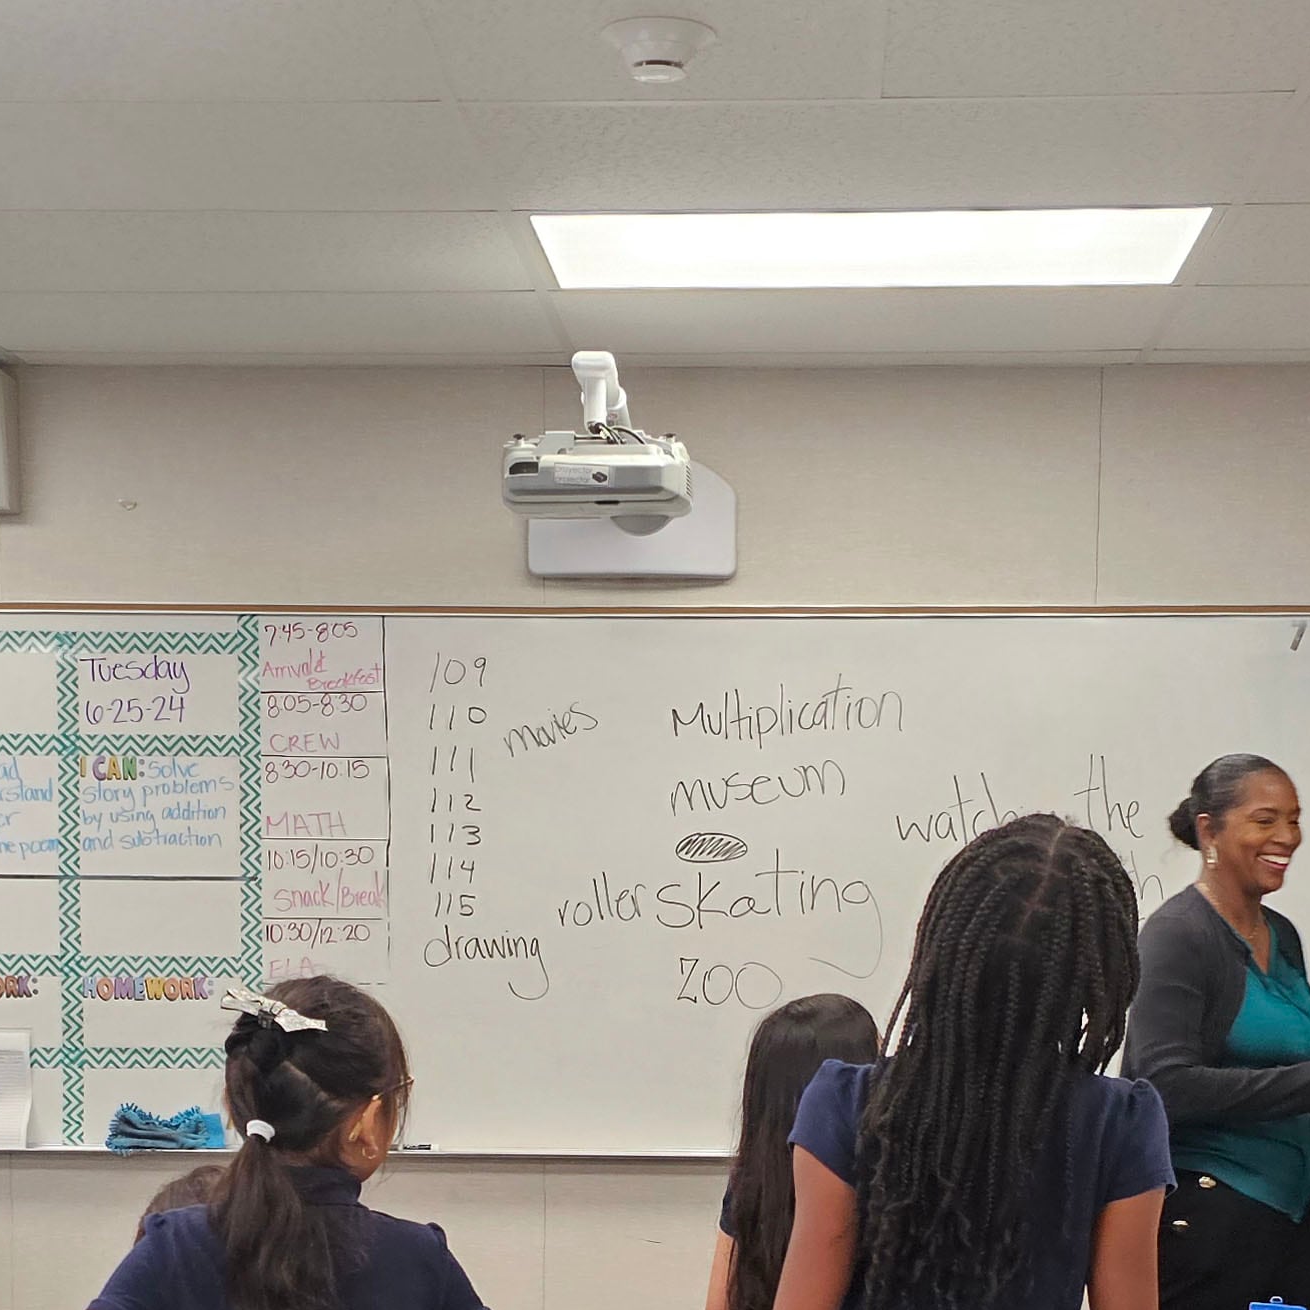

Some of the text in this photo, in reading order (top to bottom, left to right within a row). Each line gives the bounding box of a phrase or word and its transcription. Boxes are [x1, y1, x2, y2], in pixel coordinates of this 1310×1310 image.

[79, 655, 190, 694] Tuesday
[429, 652, 487, 693] 109
[86, 696, 185, 725] 6-25-24
[429, 703, 488, 731] 110
[671, 673, 903, 750] Multiplication
[270, 732, 340, 753] CREW
[503, 701, 599, 758] movies
[79, 756, 87, 779] I
[92, 755, 145, 781] CAN:
[431, 745, 475, 783] 111
[142, 776, 235, 807] problems
[431, 787, 482, 813] 112
[670, 759, 846, 817] museum
[1073, 753, 1145, 838] the
[82, 799, 227, 834] by using addition
[266, 811, 347, 837] MATH
[82, 826, 222, 852] and subtraction
[430, 823, 482, 846] 113
[430, 852, 475, 884] 114
[435, 891, 476, 917] 115
[558, 871, 647, 927] roller
[270, 956, 315, 980] ELA
[423, 924, 550, 1000] drawing
[82, 976, 214, 1001] HOMEWORK:
